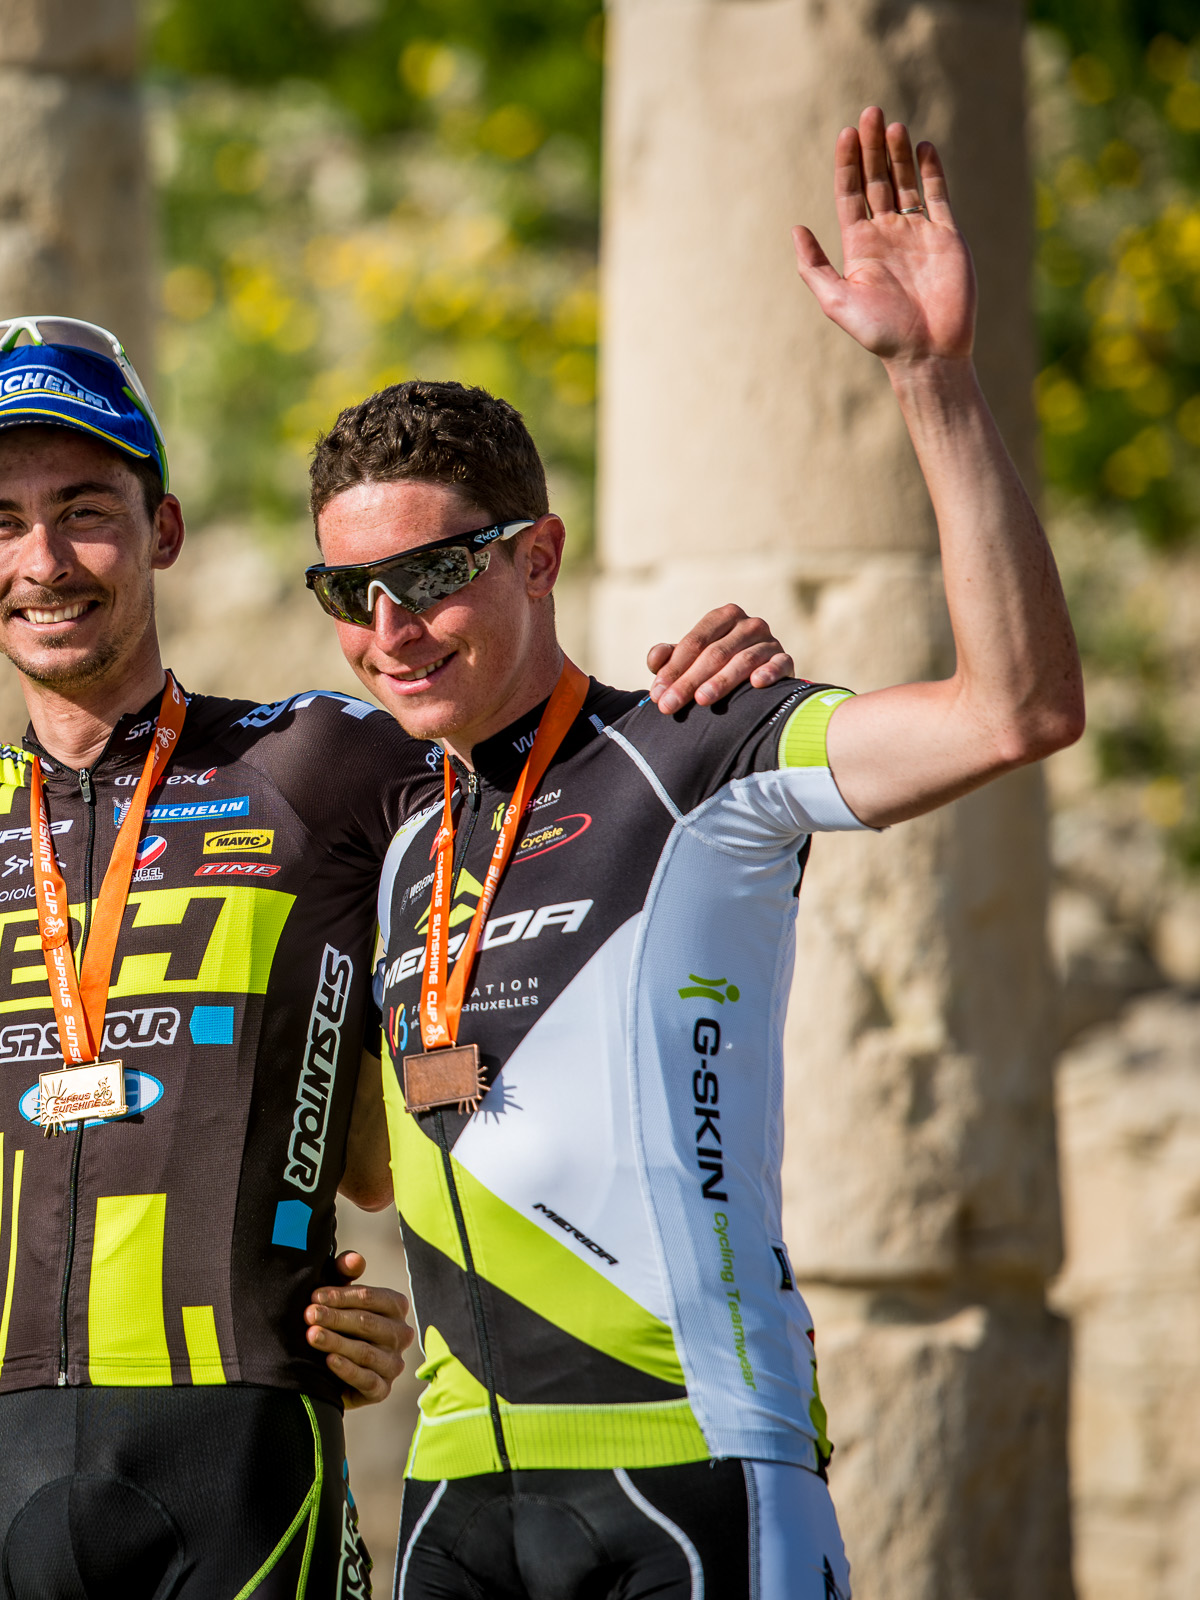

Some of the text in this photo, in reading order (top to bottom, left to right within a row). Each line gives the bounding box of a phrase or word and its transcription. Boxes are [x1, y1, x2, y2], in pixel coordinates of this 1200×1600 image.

[132, 868, 164, 878] RIBEL
[201, 863, 274, 876] TIME
[216, 836, 261, 847] MAVIC
[43, 880, 58, 915] CUP
[426, 852, 444, 1023] CYPRUS SUNSHINE CUP
[52, 946, 73, 1009] CYPRUS
[692, 1016, 729, 1203] G-SKIN
[531, 1202, 620, 1266] MERIDA
[713, 1211, 757, 1392] Cycling Teamwear
